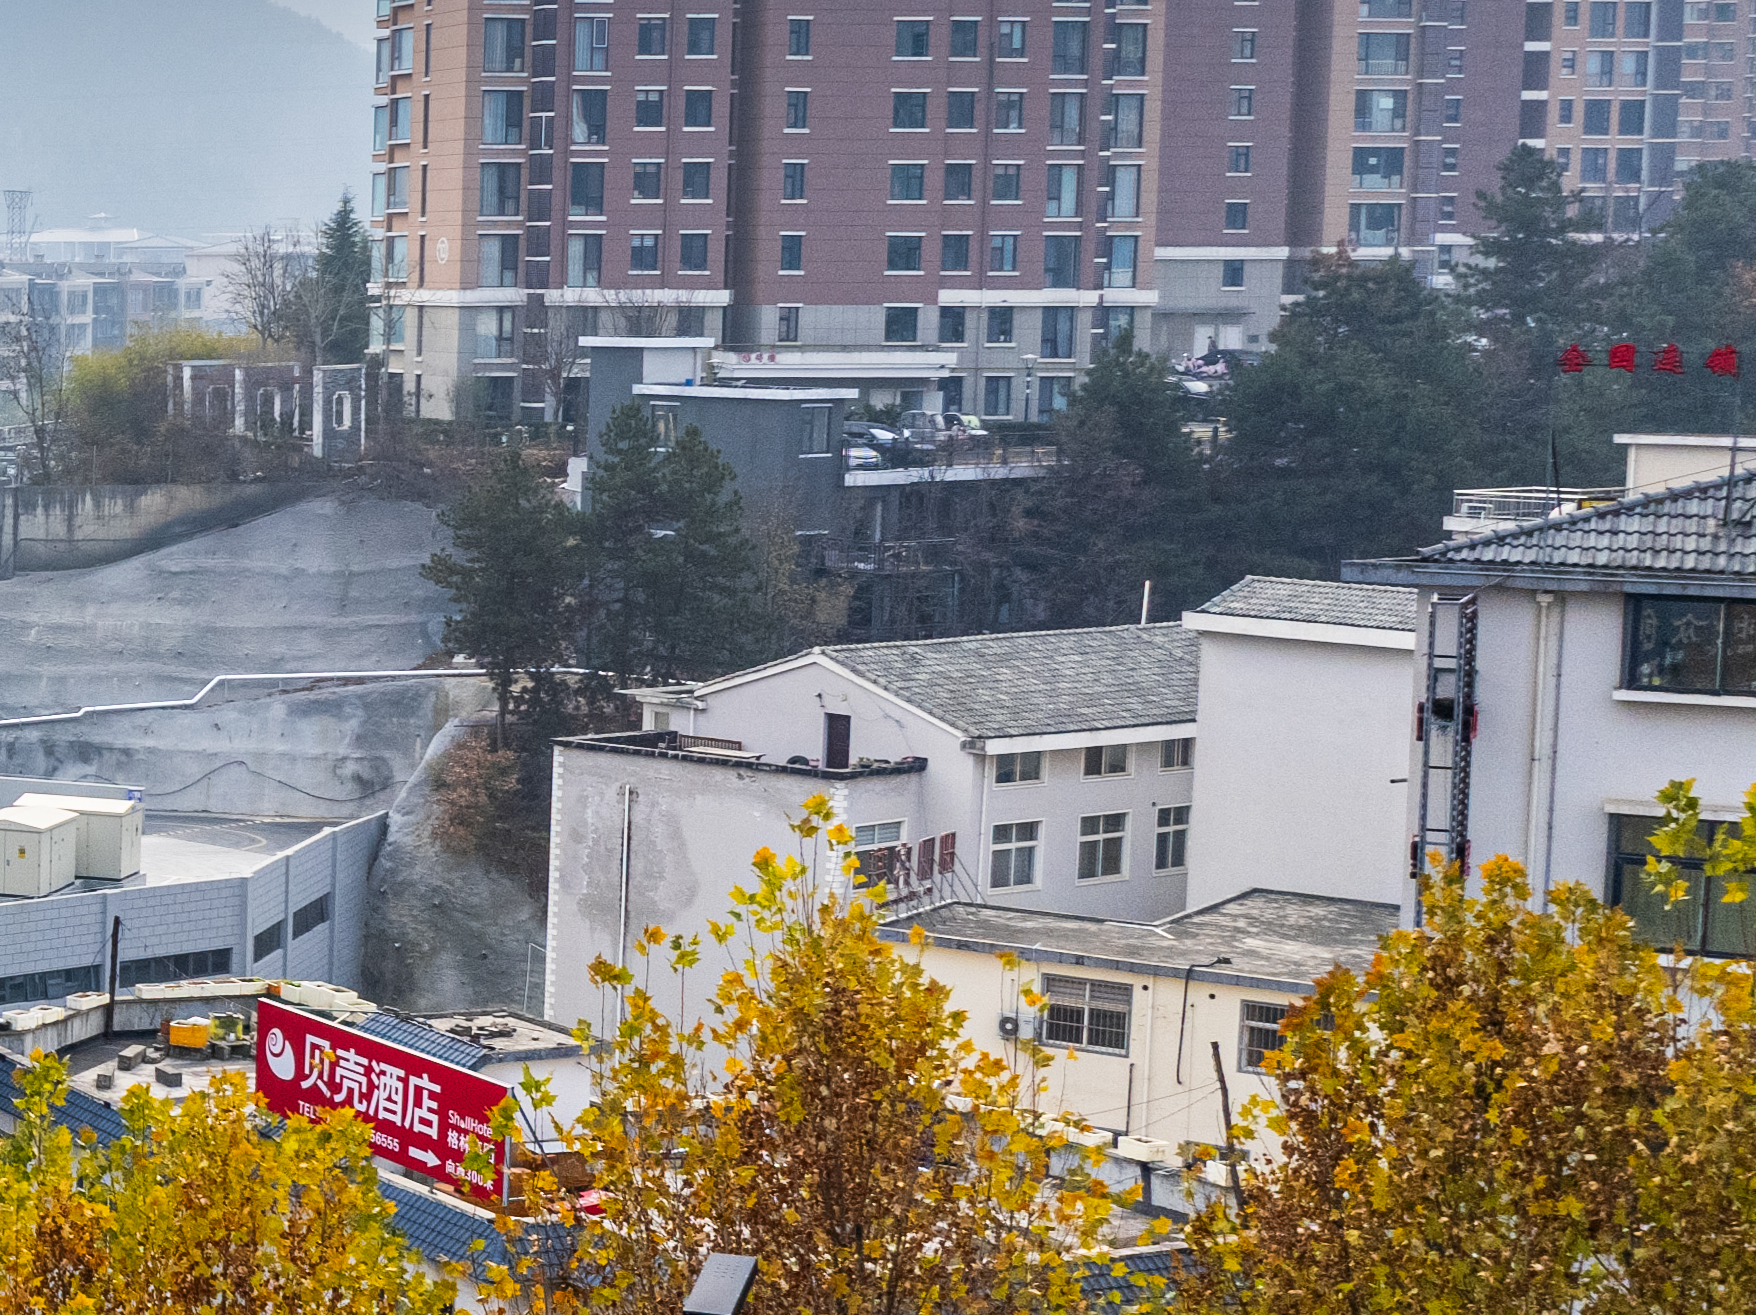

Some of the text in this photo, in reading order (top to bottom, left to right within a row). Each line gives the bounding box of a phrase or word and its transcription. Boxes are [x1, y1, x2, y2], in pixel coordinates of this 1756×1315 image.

[299, 1033, 442, 1141] 贝壳酒店
[447, 1109, 493, 1139] ShellHote
